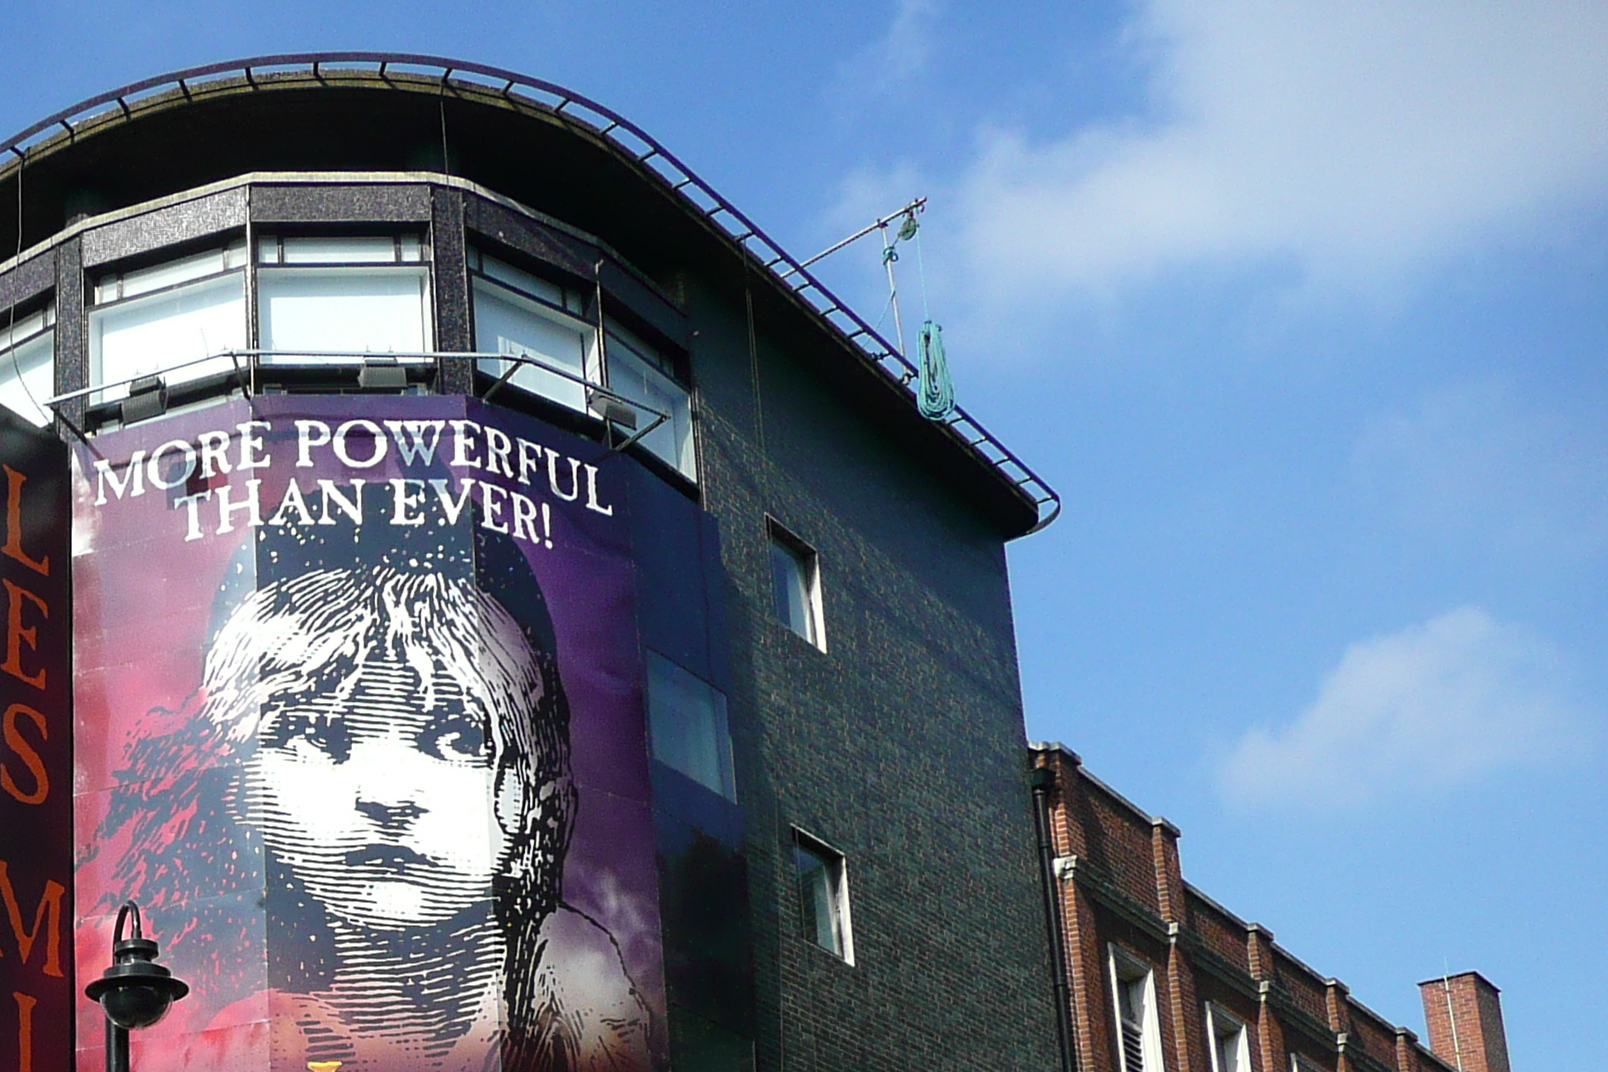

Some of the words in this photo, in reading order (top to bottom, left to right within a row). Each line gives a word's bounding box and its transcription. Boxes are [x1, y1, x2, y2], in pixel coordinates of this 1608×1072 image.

[93, 419, 272, 507] MORE
[295, 418, 614, 517] POWERFUL
[174, 476, 367, 543] THAN
[390, 476, 554, 550] EVER!
[0, 463, 50, 806] LES
